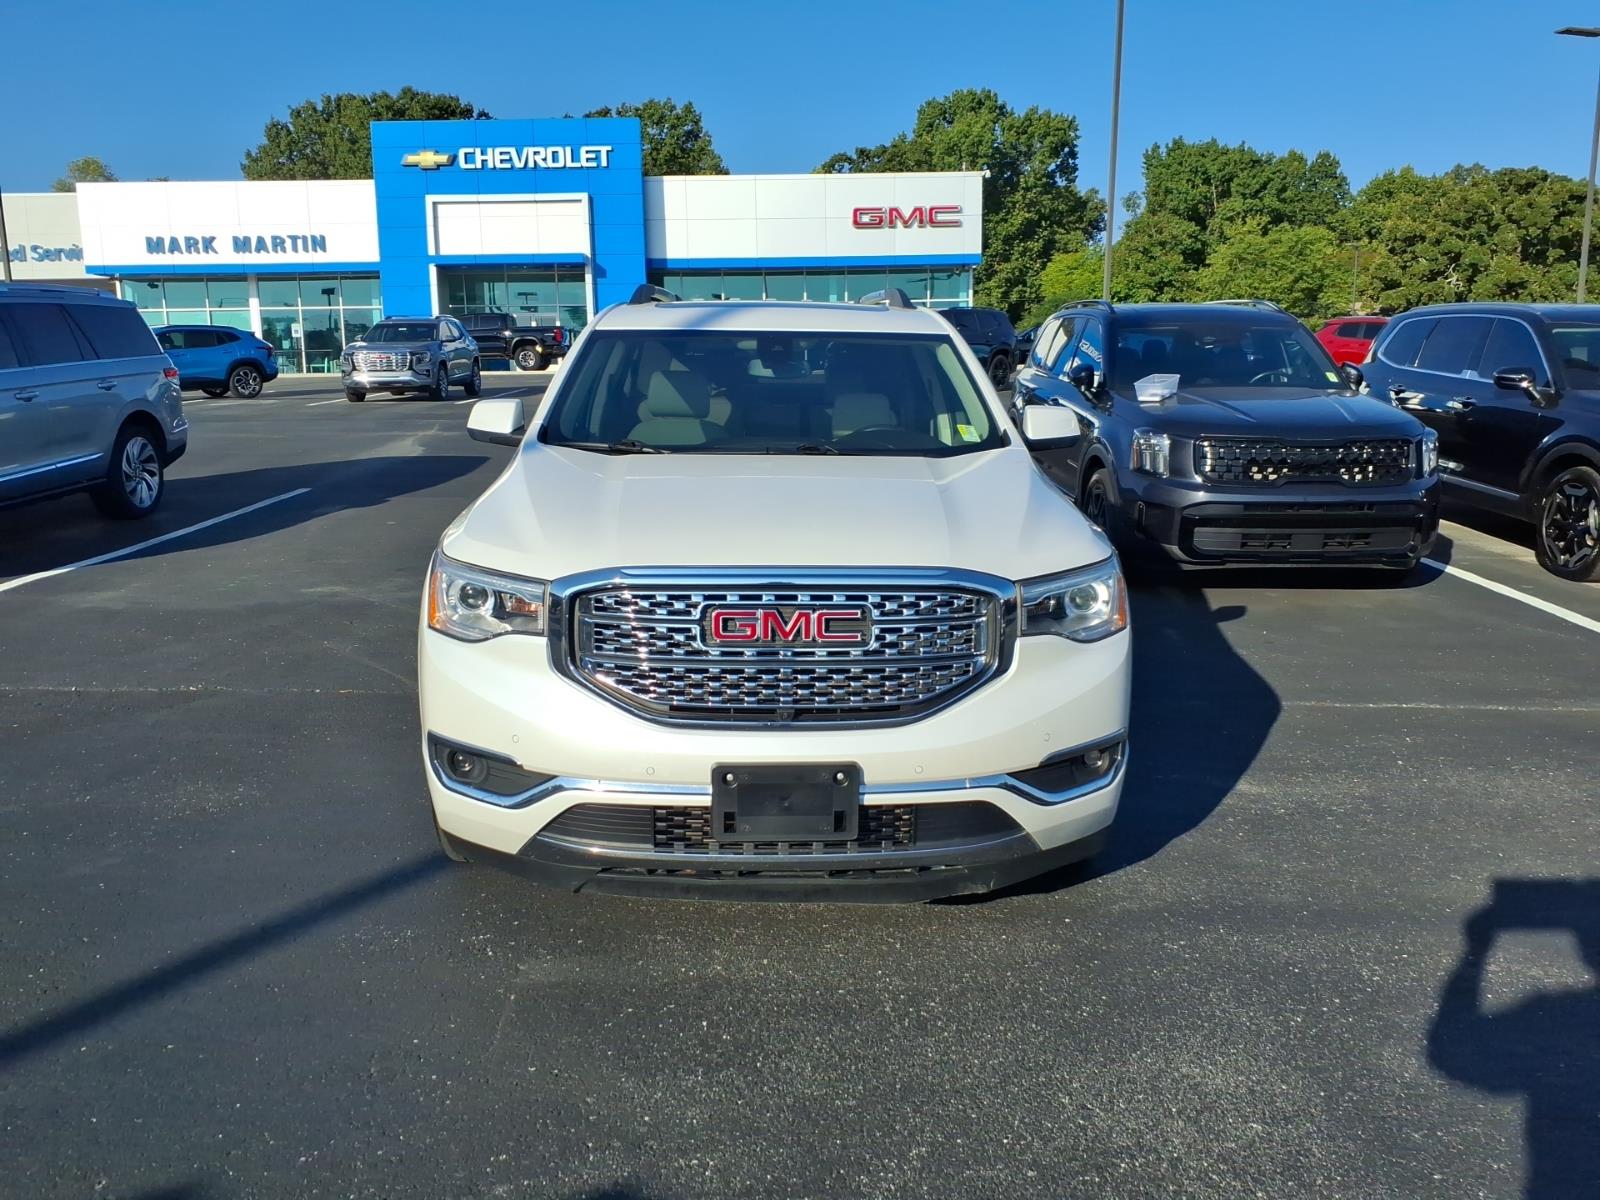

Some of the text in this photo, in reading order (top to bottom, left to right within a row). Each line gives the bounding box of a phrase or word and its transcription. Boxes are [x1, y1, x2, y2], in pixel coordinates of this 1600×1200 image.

[458, 146, 612, 169] CHEVROLET
[852, 205, 962, 228] GMC
[30, 244, 84, 262] Servi
[145, 234, 327, 255] MARK MARTIN
[712, 609, 861, 641] GMC
